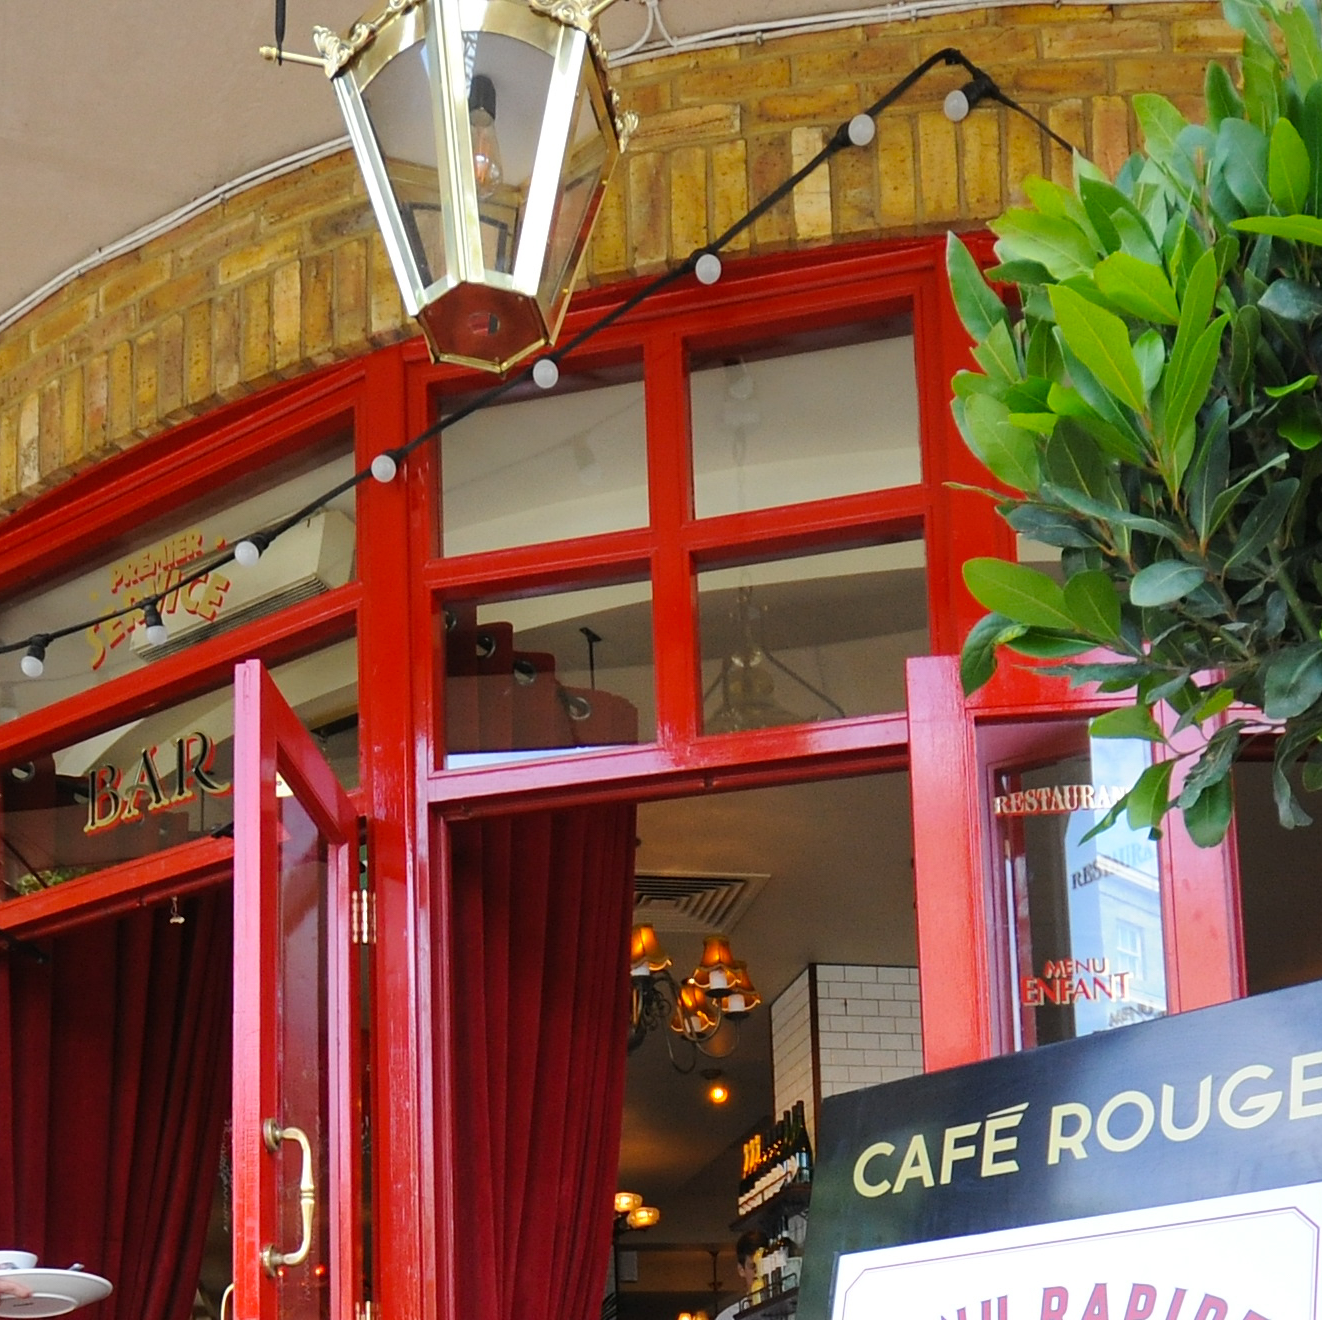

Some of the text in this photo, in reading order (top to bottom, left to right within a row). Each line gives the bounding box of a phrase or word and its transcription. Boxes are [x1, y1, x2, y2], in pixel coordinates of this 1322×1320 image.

[109, 528, 204, 595] PREMIER
[83, 731, 234, 837] BAR
[994, 784, 1131, 817] RESTAURAN
[1019, 971, 1134, 1006] ENFANT
[1043, 956, 1110, 980] MENU
[853, 1101, 1029, 1199] CAFÉ
